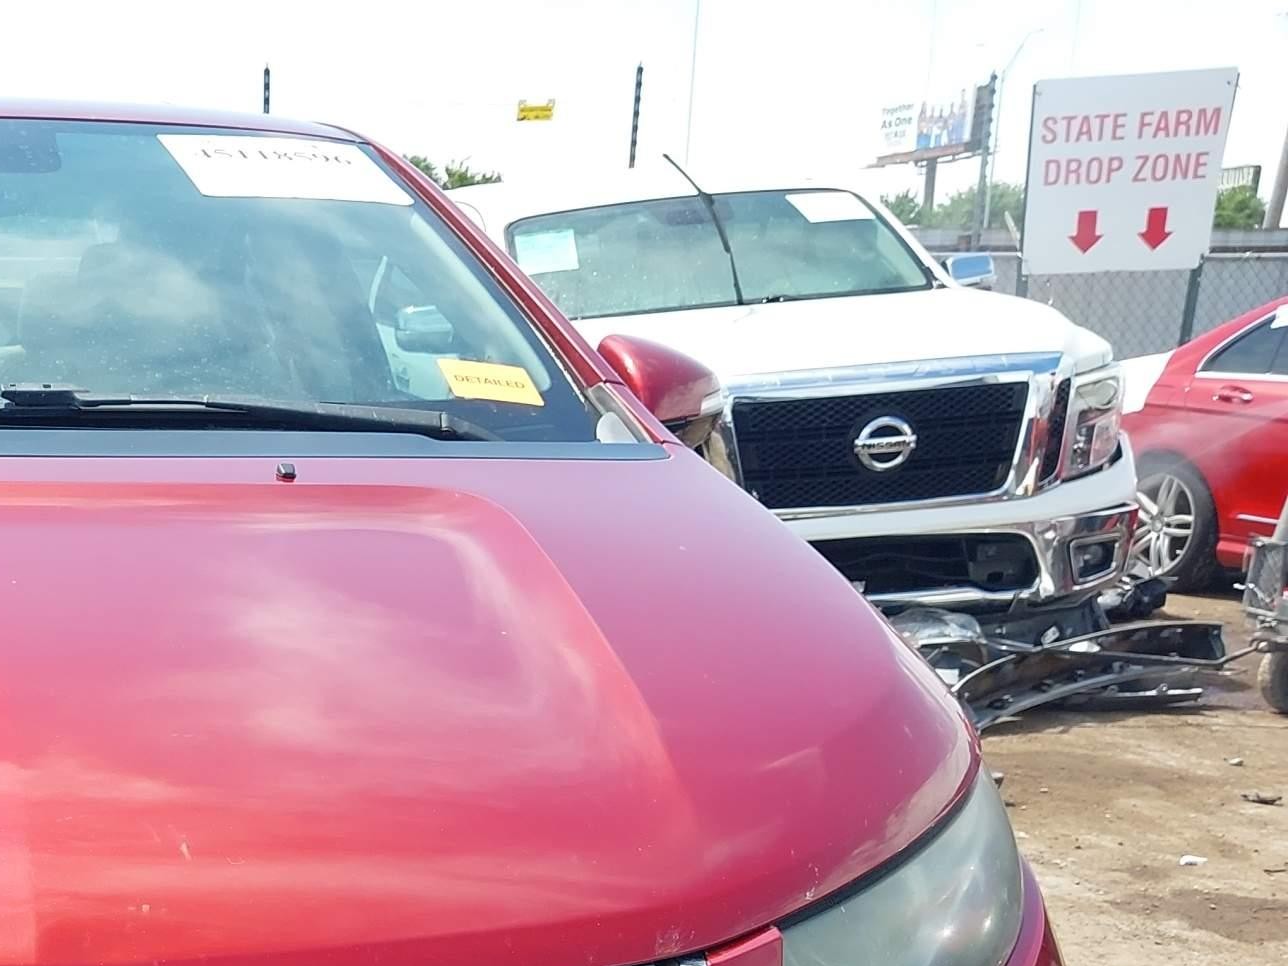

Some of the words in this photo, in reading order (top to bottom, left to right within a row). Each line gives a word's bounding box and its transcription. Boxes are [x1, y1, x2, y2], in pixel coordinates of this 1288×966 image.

[1041, 112, 1128, 144] STATE
[1136, 106, 1223, 140] FARM
[1043, 155, 1124, 187] DROP
[1131, 151, 1210, 183] ZONE
[453, 374, 526, 389] DETAILED
